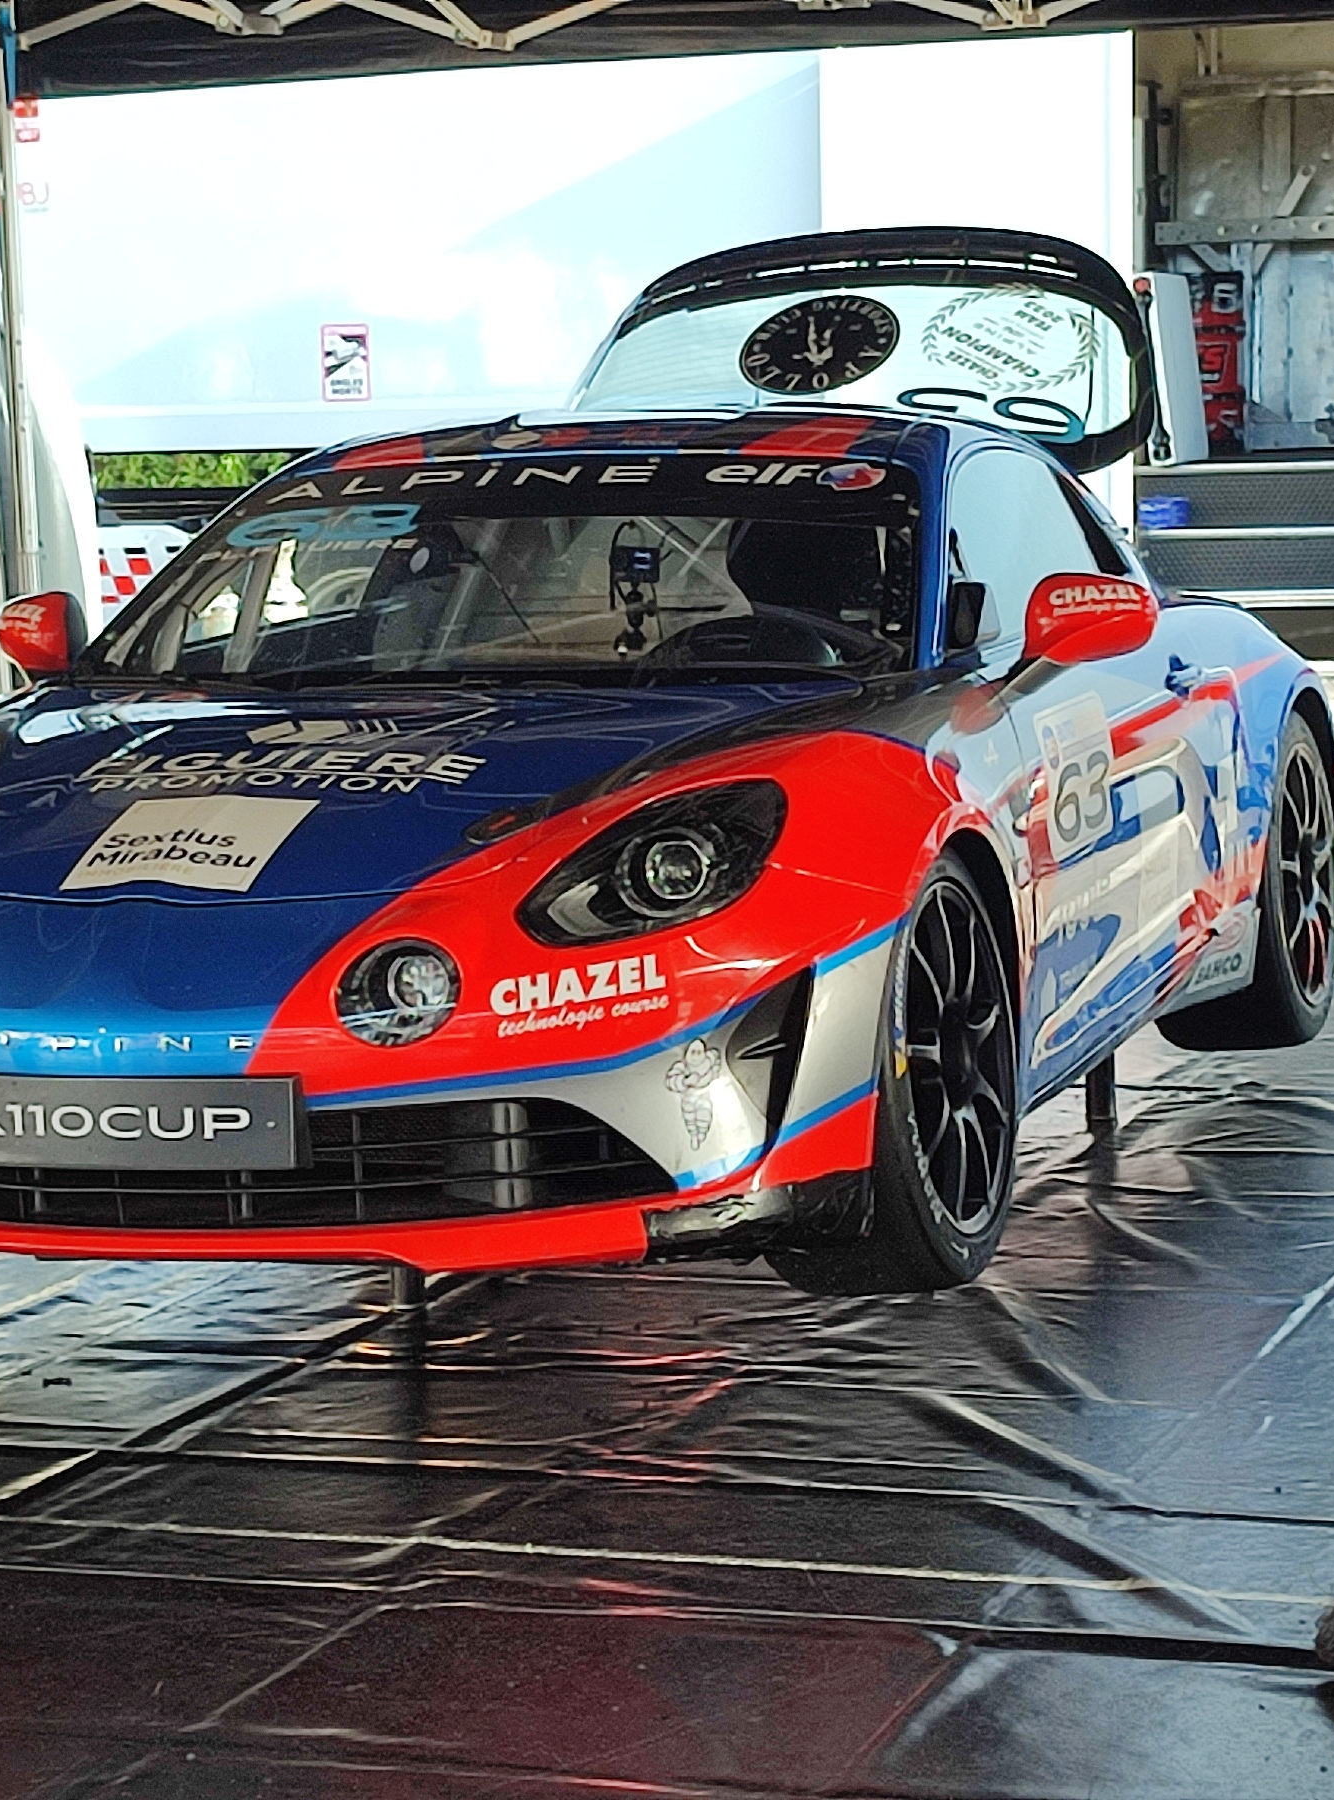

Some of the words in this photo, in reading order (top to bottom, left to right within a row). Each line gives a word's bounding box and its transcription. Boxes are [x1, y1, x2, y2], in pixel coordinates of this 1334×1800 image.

[745, 345, 884, 392] APOLLO
[940, 325, 1041, 378] CHAMPION
[267, 461, 659, 505] ALPINE
[705, 462, 820, 485] elf
[1048, 583, 1141, 606] CHAZEL
[75, 751, 487, 785] FIGUIERE
[88, 773, 424, 793] PROMOTION
[1055, 750, 1109, 843] 63
[86, 845, 258, 870] Mirabeau
[102, 828, 238, 850] Sextius
[490, 953, 666, 1016] CHAZEL
[498, 1004, 606, 1038] technologie
[611, 995, 670, 1018] course
